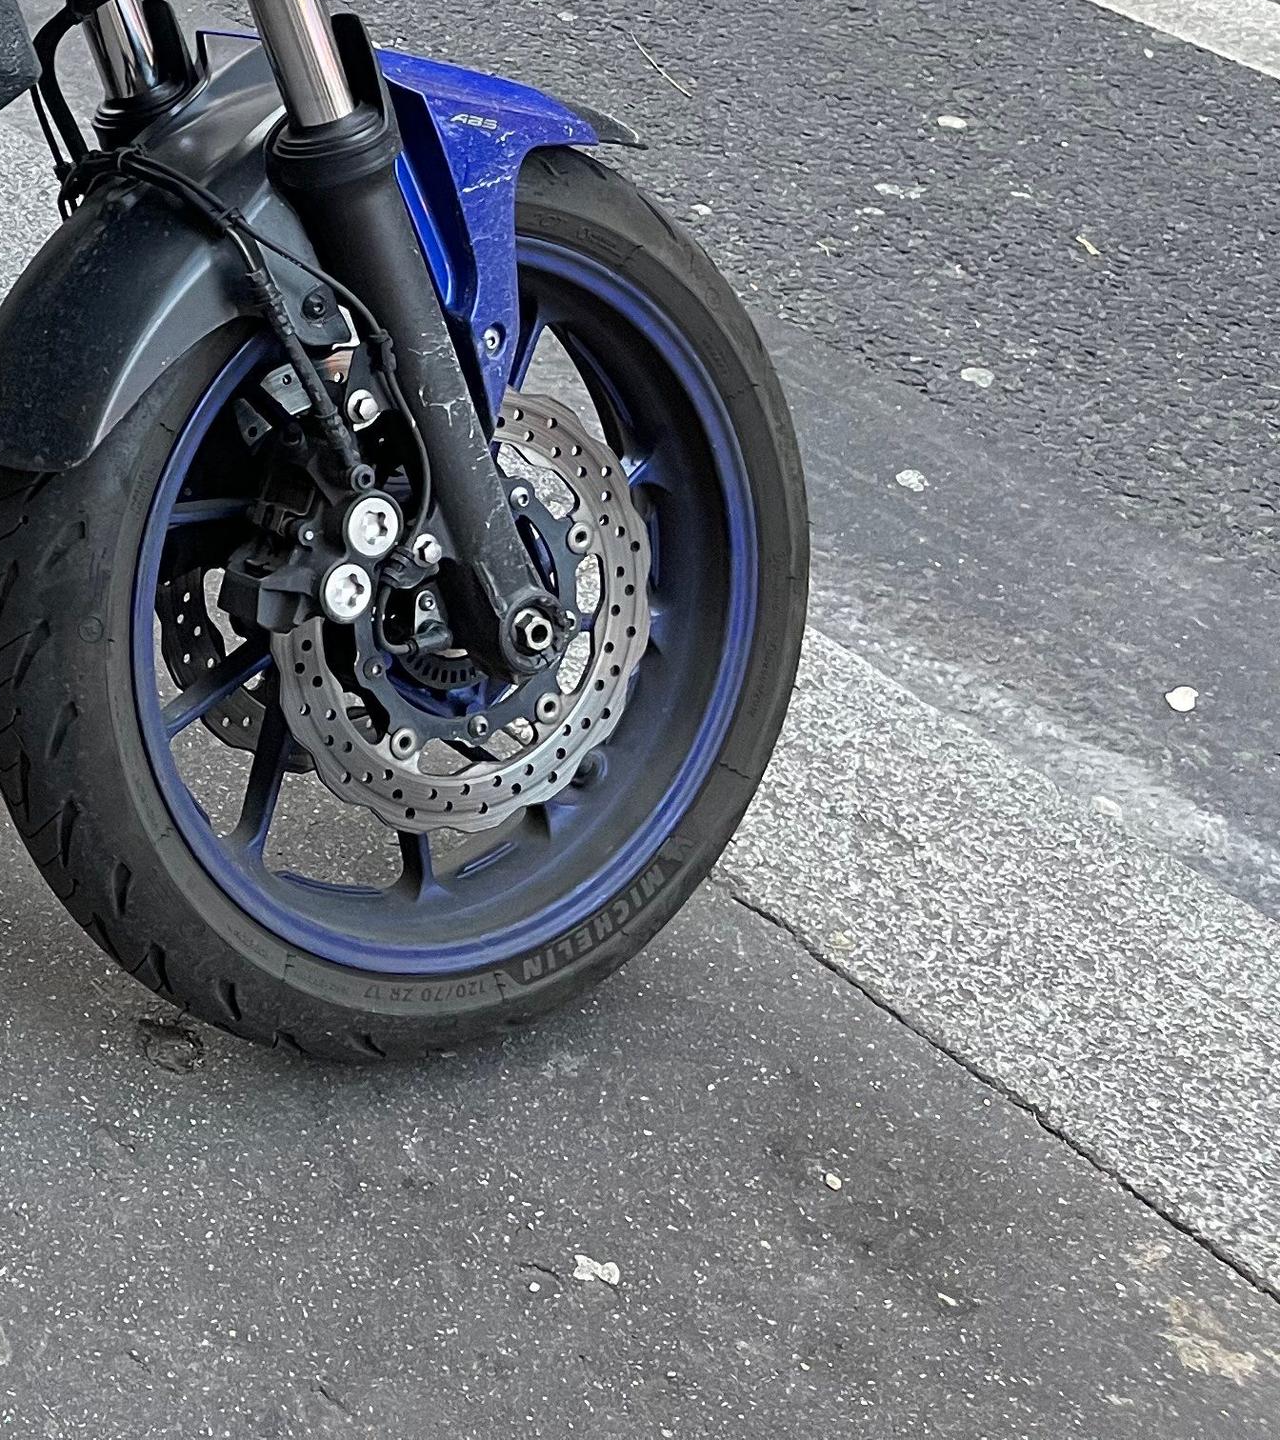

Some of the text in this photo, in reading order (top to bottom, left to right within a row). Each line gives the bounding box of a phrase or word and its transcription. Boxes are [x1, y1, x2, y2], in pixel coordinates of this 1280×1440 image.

[450, 113, 498, 130] ABS
[523, 864, 666, 982] MICHELIN
[420, 983, 485, 1002] 120/70
